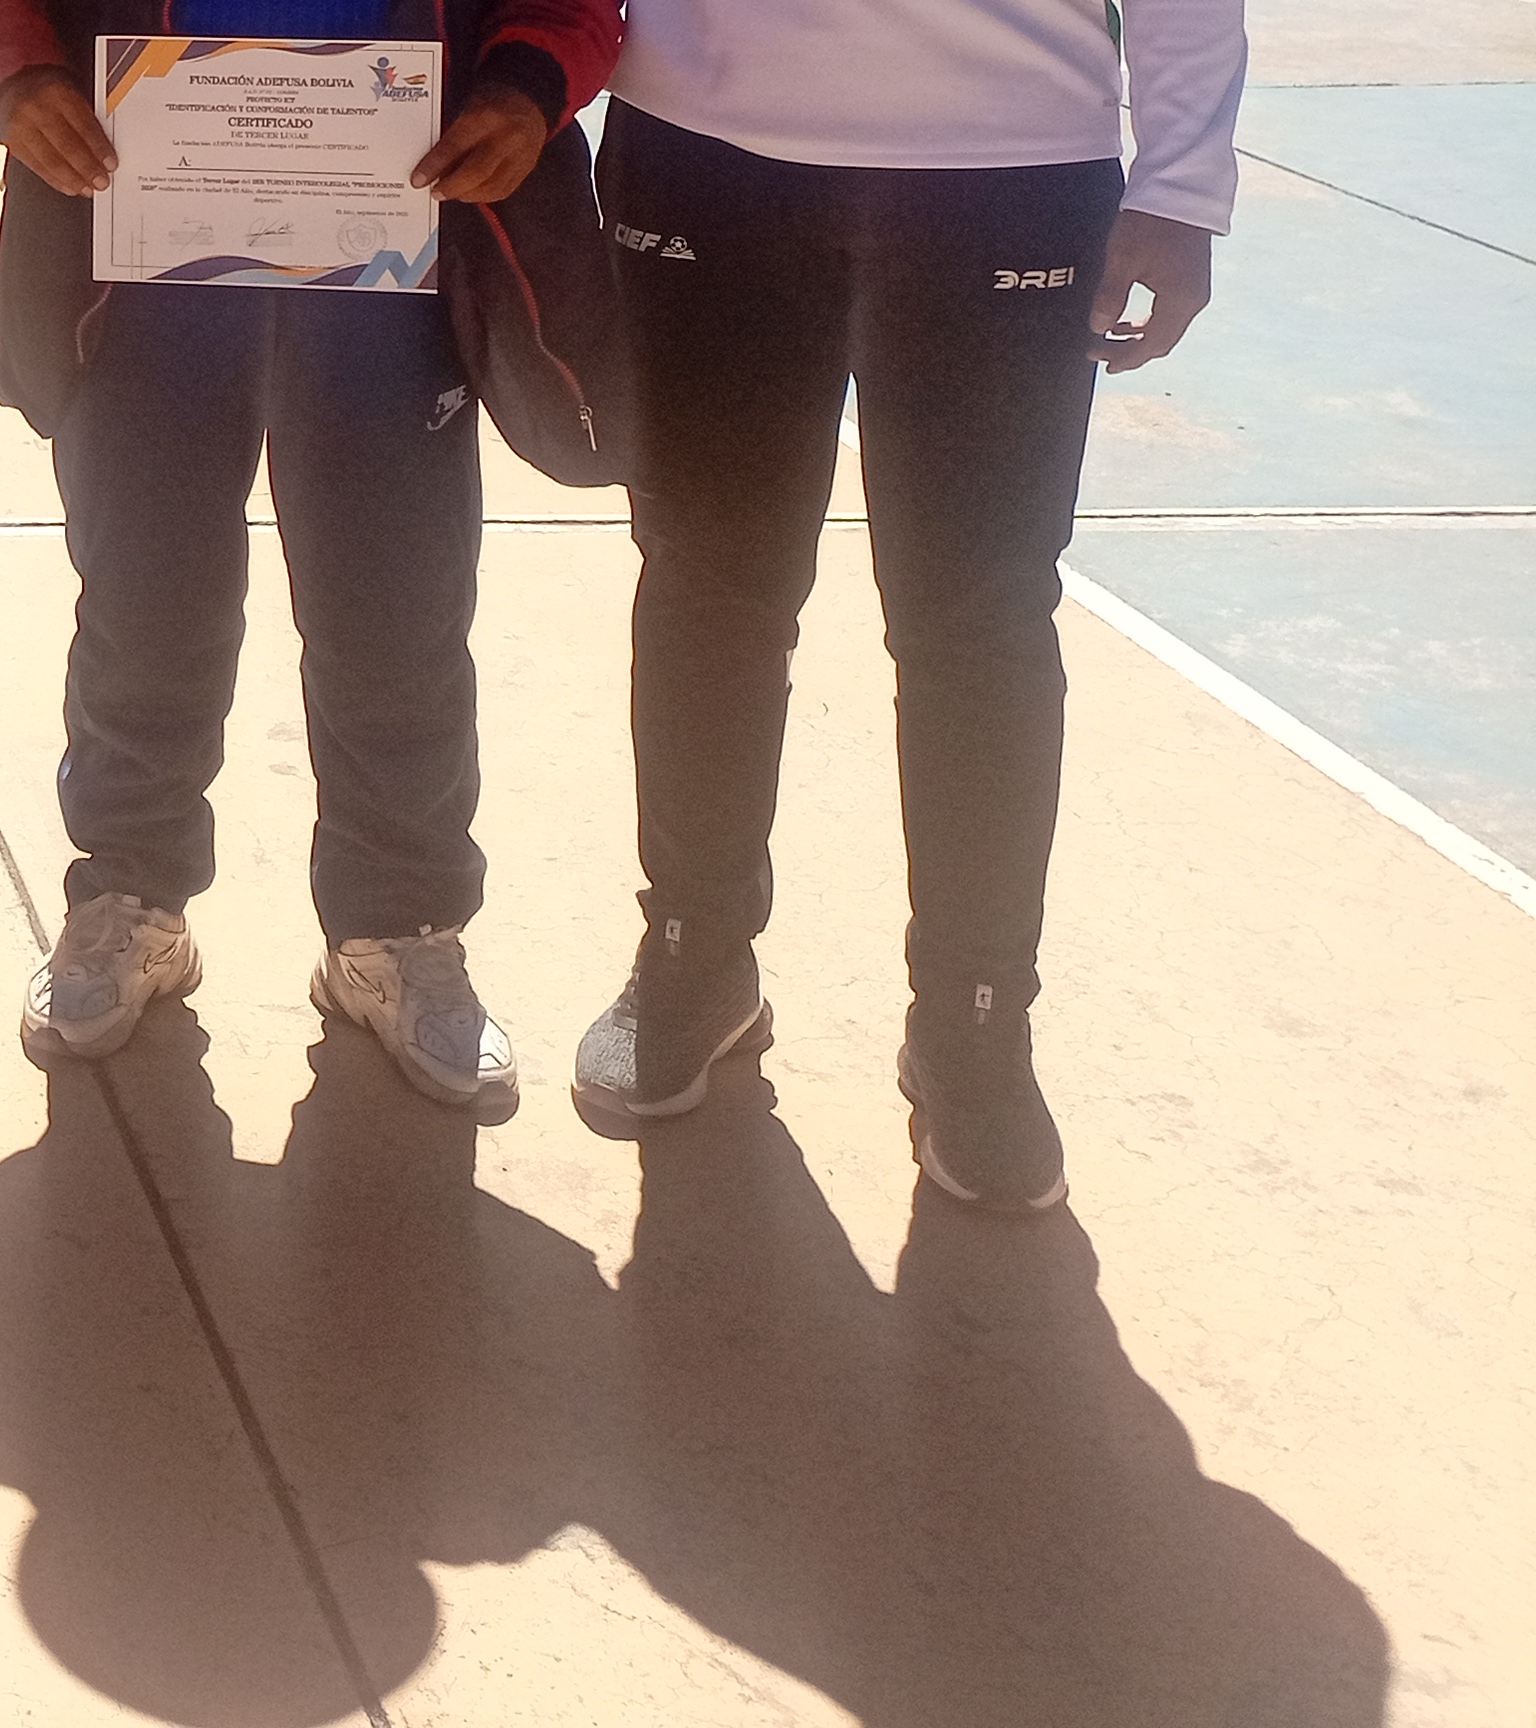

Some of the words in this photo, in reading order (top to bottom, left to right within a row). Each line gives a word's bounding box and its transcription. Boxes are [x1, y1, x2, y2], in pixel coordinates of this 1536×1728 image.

[188, 73, 254, 86] FUNDACIÓN
[255, 76, 308, 87] ADEFUSA
[310, 77, 354, 88] BOLIVIA
[227, 116, 313, 129] CERTIFICADO
